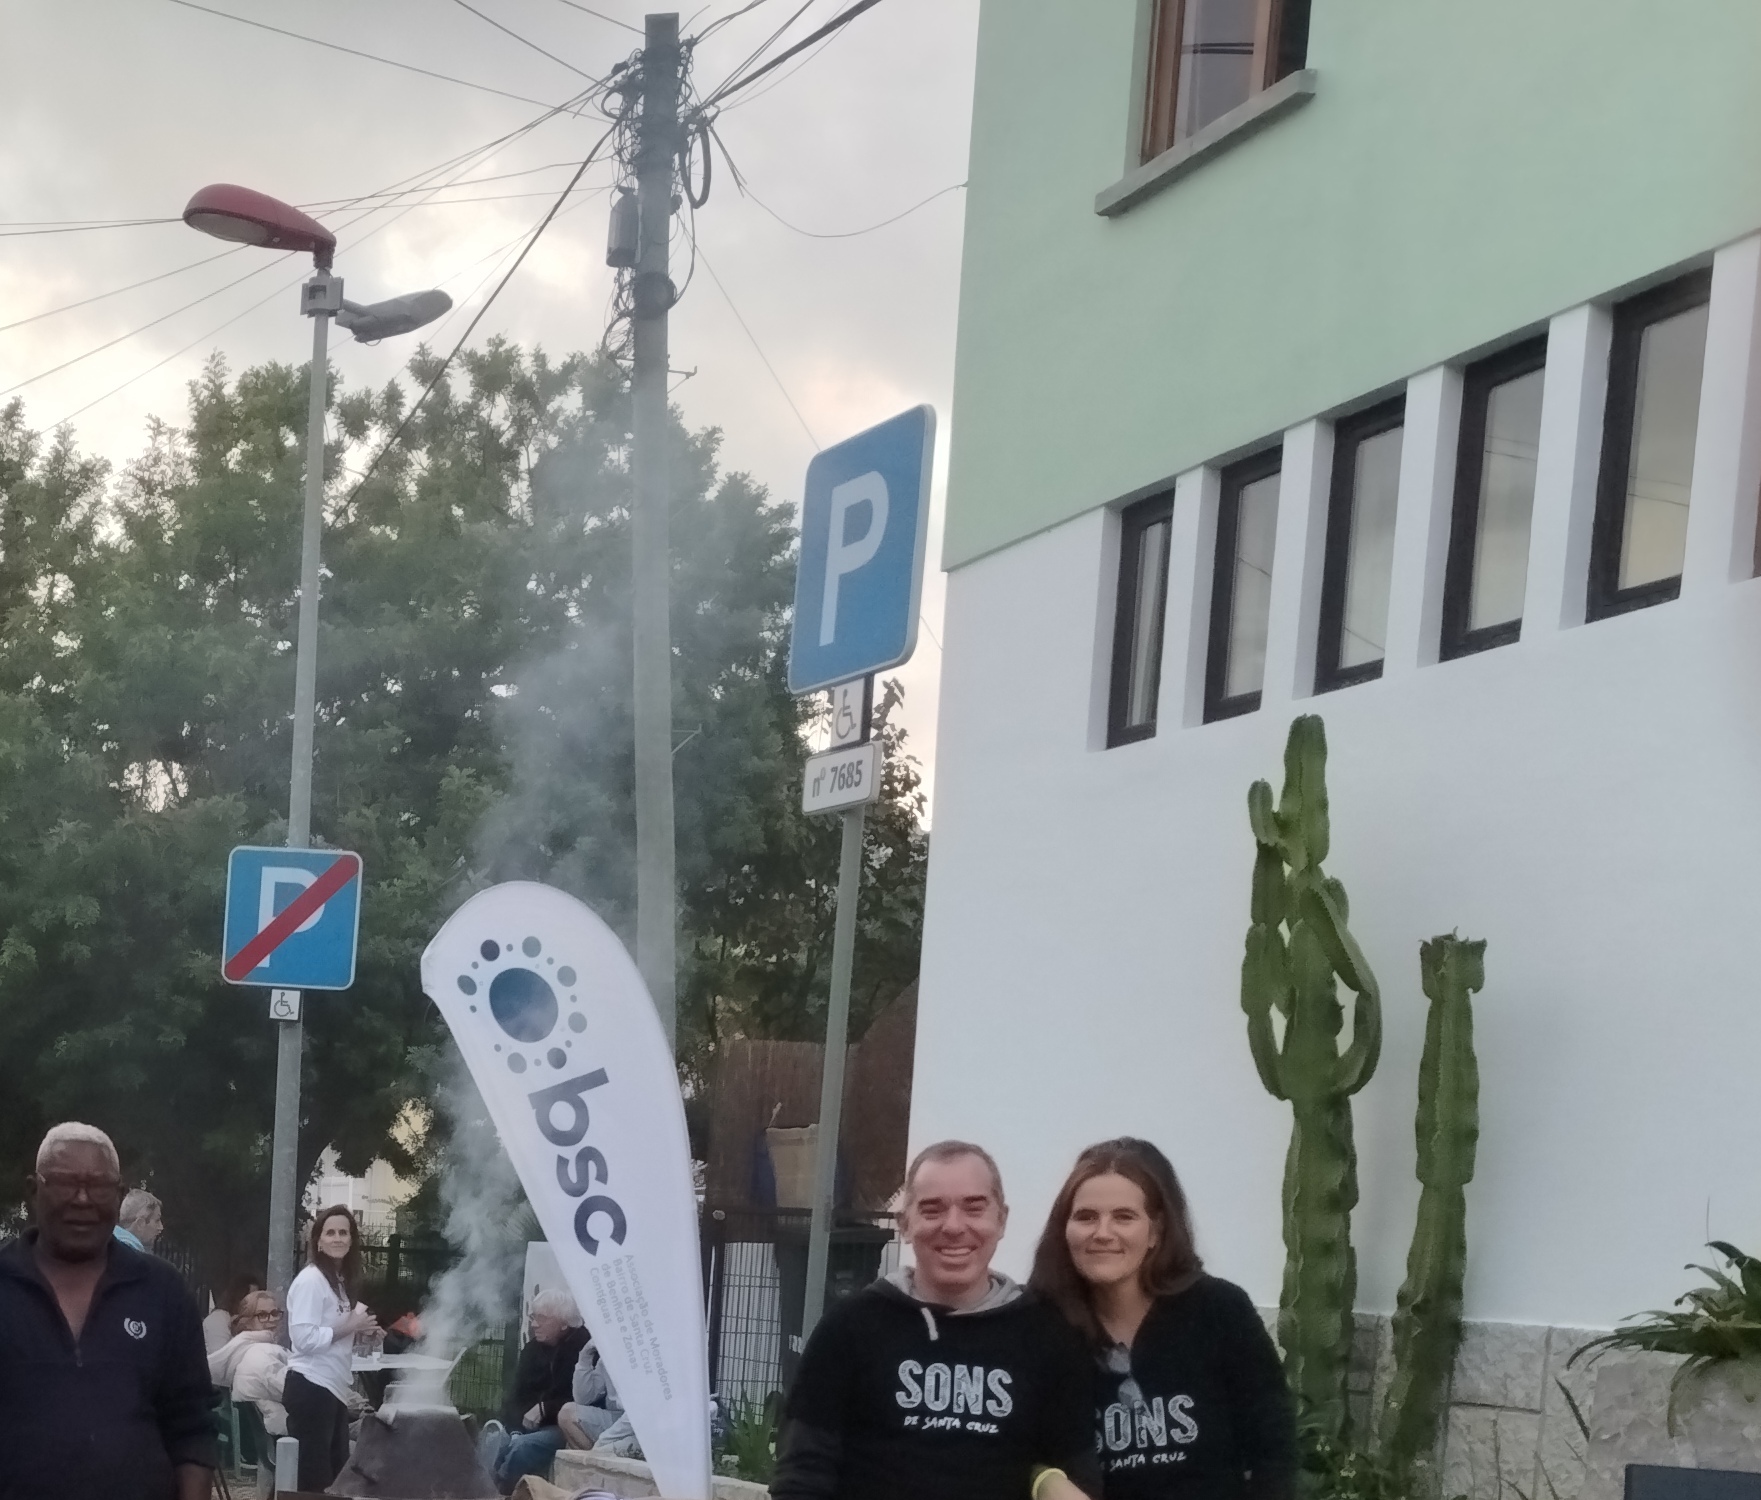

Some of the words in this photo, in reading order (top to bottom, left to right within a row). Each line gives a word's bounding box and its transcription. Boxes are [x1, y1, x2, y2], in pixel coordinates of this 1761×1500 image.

[819, 471, 889, 646] P
[829, 759, 864, 794] 7685
[256, 866, 325, 968] P
[527, 1067, 627, 1257] bsc
[601, 1263, 611, 1278] de
[606, 1279, 624, 1323] Benfica
[613, 1258, 629, 1294] Bairro
[624, 1296, 635, 1311] de
[630, 1313, 644, 1347] Santa
[640, 1349, 653, 1375] Cruz
[620, 1325, 628, 1333] e
[622, 1335, 639, 1370] Zonas
[624, 1254, 649, 1318] Associação
[644, 1319, 654, 1334] de
[649, 1336, 673, 1401] Moradores
[895, 1359, 1013, 1418] SONS
[904, 1415, 919, 1426] DE
[921, 1416, 961, 1430] SANTA
[966, 1421, 999, 1434] CRUZ
[1095, 1394, 1199, 1454] ONS
[1152, 1451, 1187, 1465] CRUZ
